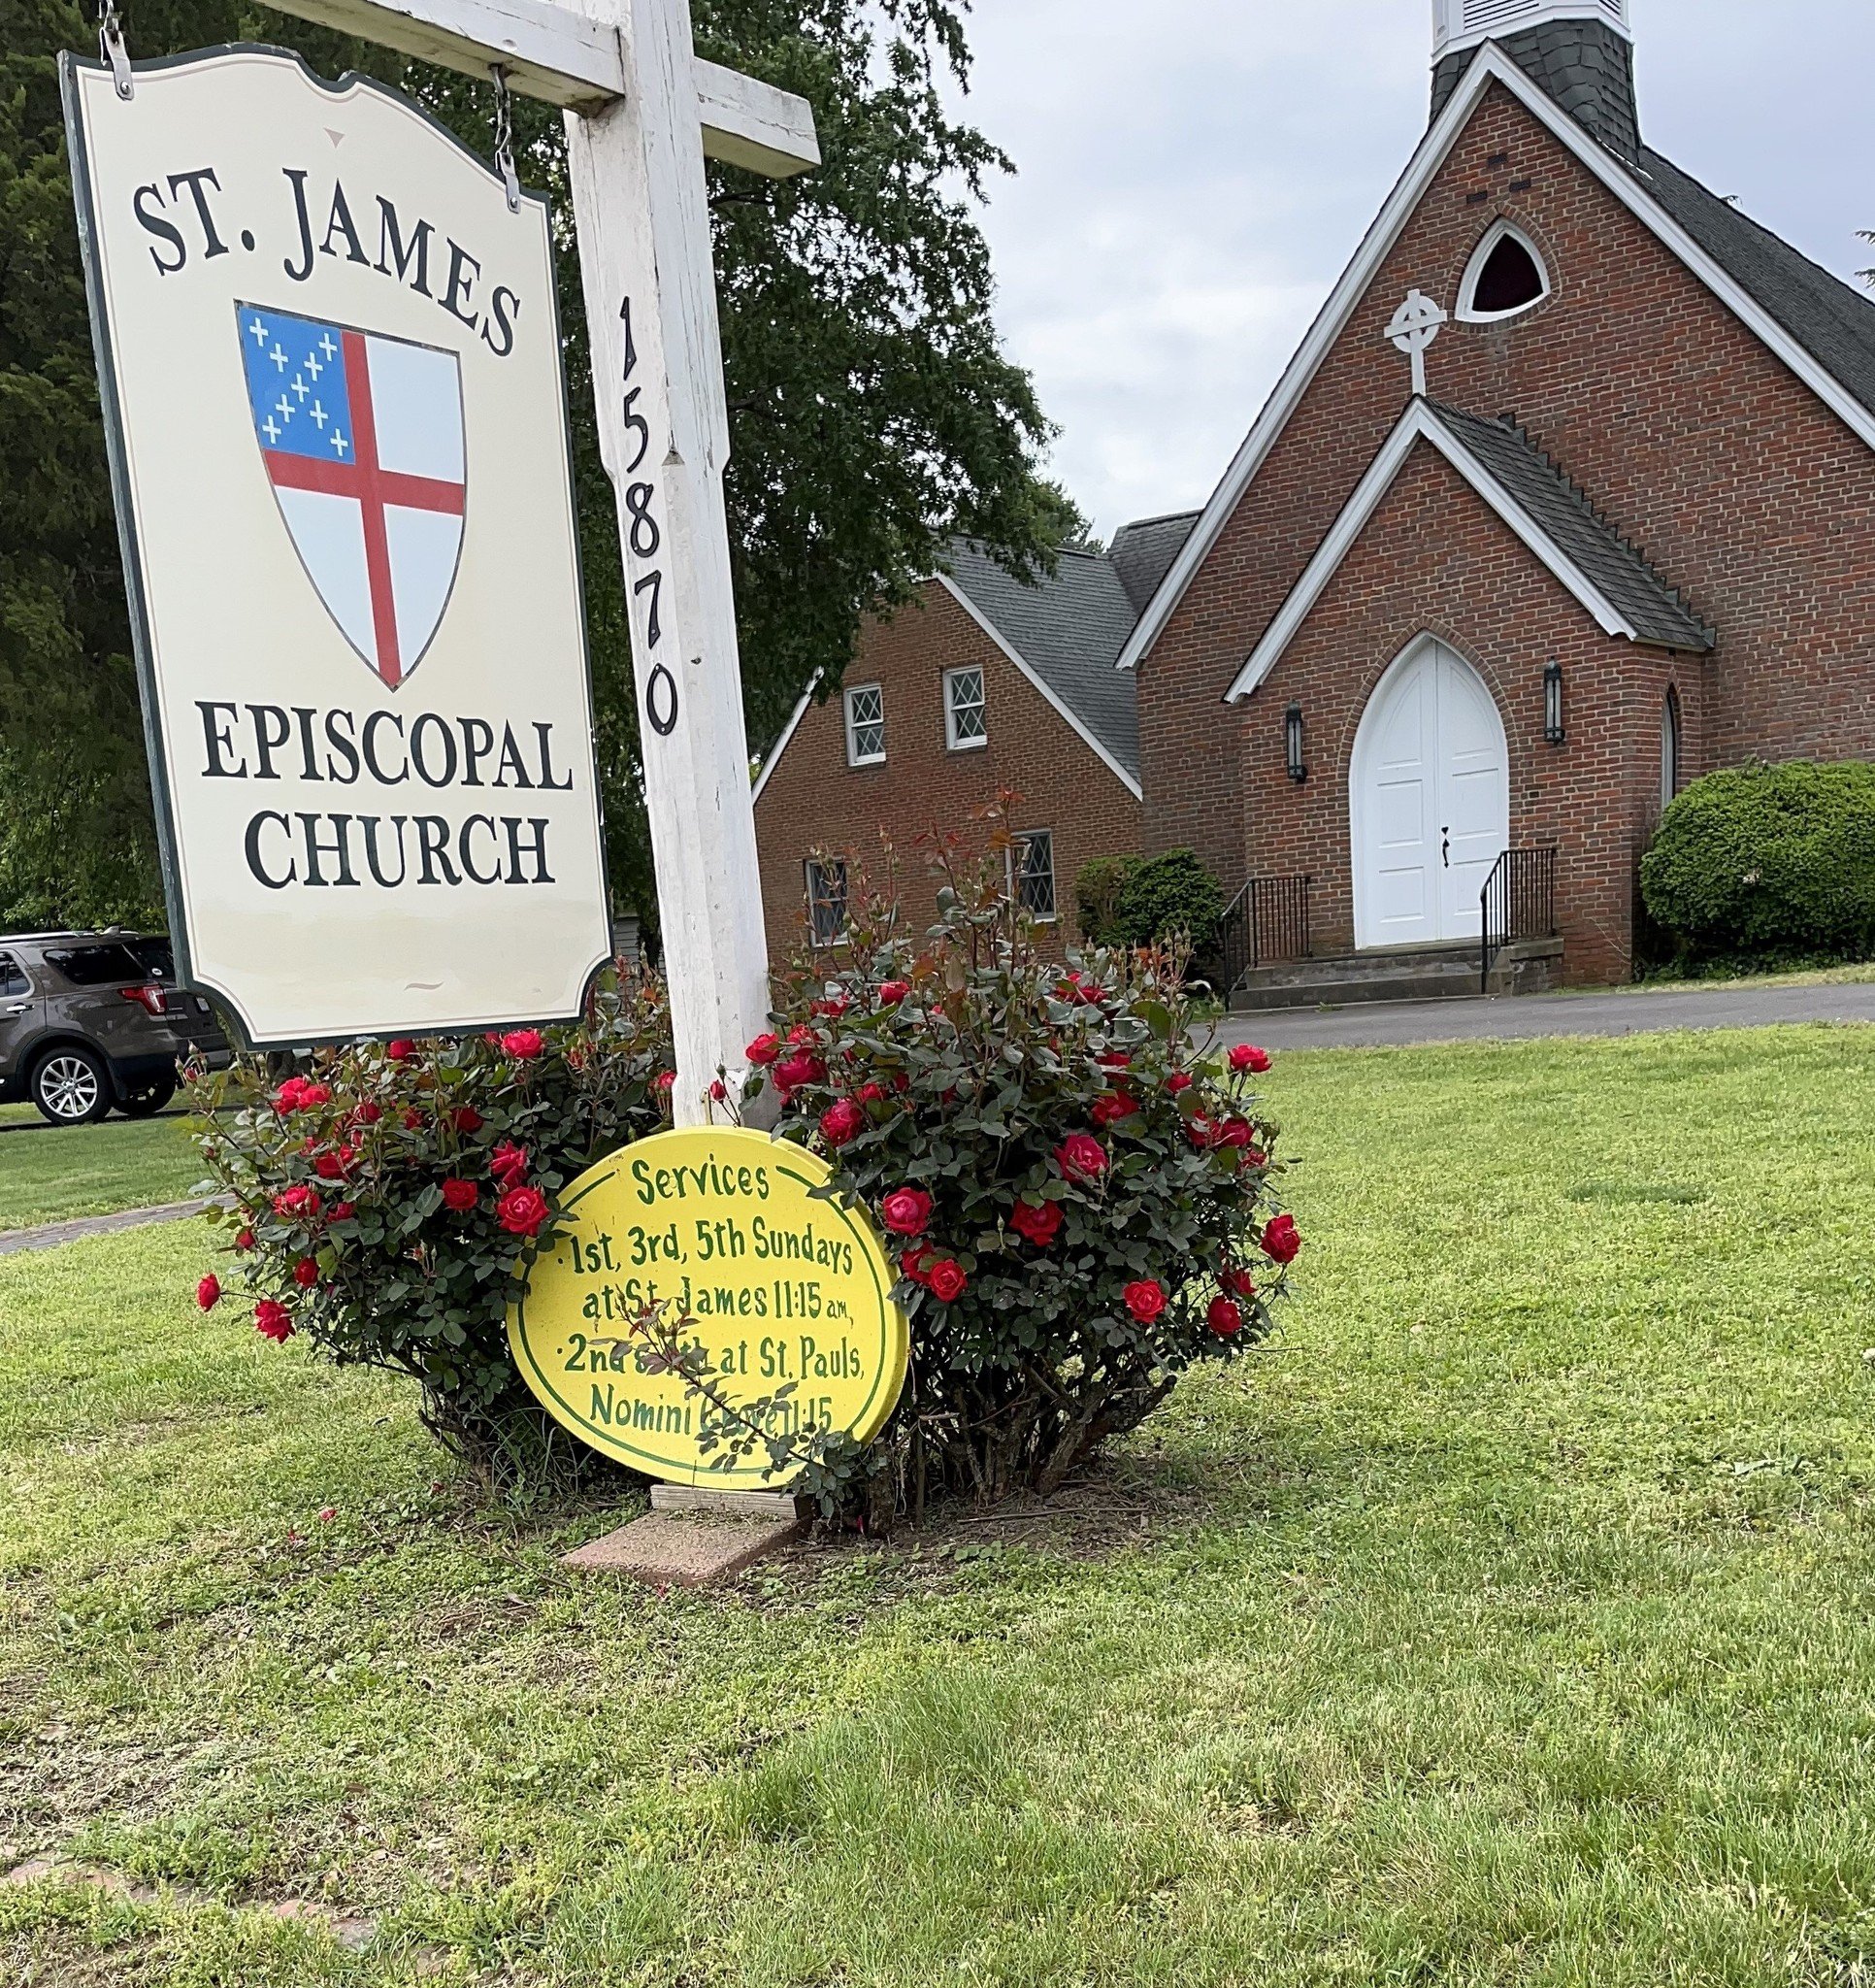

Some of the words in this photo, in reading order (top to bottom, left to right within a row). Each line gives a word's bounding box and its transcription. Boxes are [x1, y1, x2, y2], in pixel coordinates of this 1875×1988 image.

[132, 166, 257, 277] ST.
[281, 167, 521, 357] JAMES
[619, 295, 678, 736] 15870
[194, 700, 575, 791] EPISCOPAL
[244, 810, 557, 889] CHURCH
[631, 1153, 770, 1206] Services
[570, 1232, 622, 1274] 1st,
[627, 1222, 688, 1266] 3rd,
[696, 1218, 745, 1260] 5th
[752, 1215, 853, 1276] Sundays
[582, 1284, 615, 1320] at
[675, 1276, 768, 1318] James
[773, 1280, 822, 1319] 11:15
[720, 1340, 747, 1375] at
[759, 1337, 794, 1379] St.
[800, 1335, 866, 1380] Pauls,
[589, 1383, 692, 1436] Nomini
